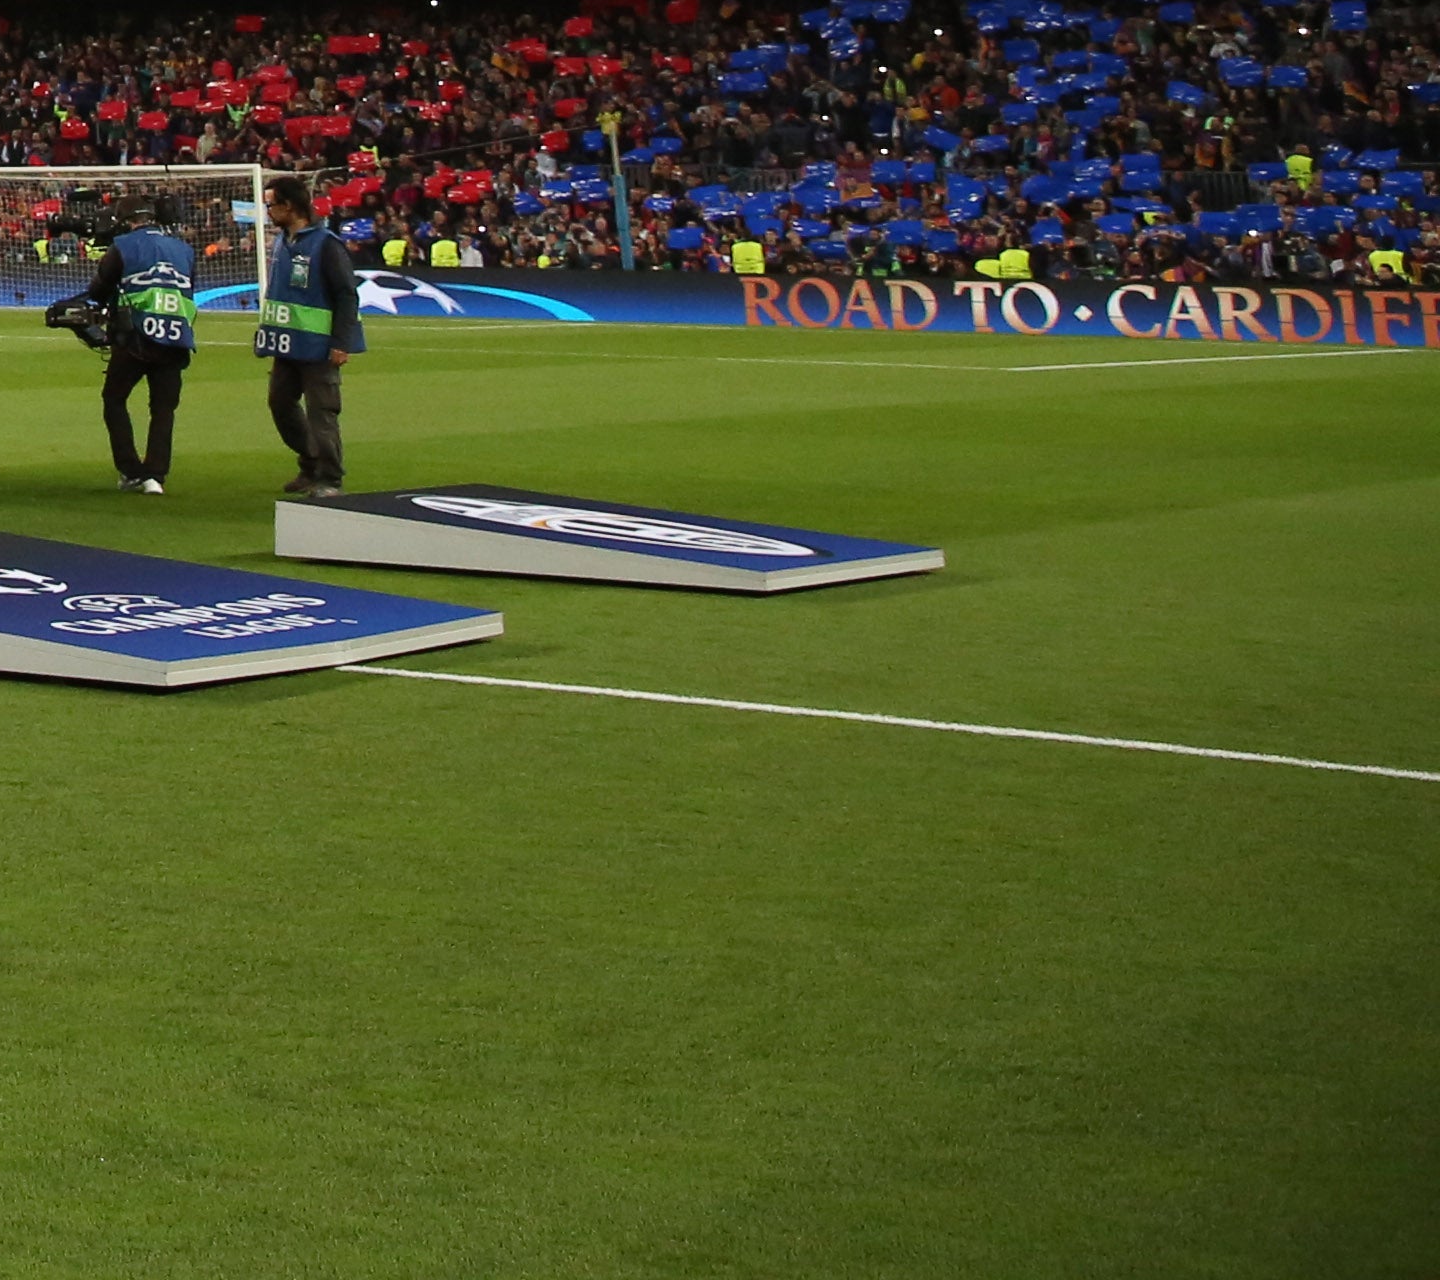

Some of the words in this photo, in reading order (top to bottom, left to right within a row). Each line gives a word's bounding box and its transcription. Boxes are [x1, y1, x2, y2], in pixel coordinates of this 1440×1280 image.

[265, 304, 291, 324] HB
[739, 277, 938, 331] ROAD
[953, 281, 1060, 334] TO
[256, 329, 291, 354] 038
[50, 592, 326, 635] CHAMPIONS
[183, 613, 336, 639] LEAGUE
